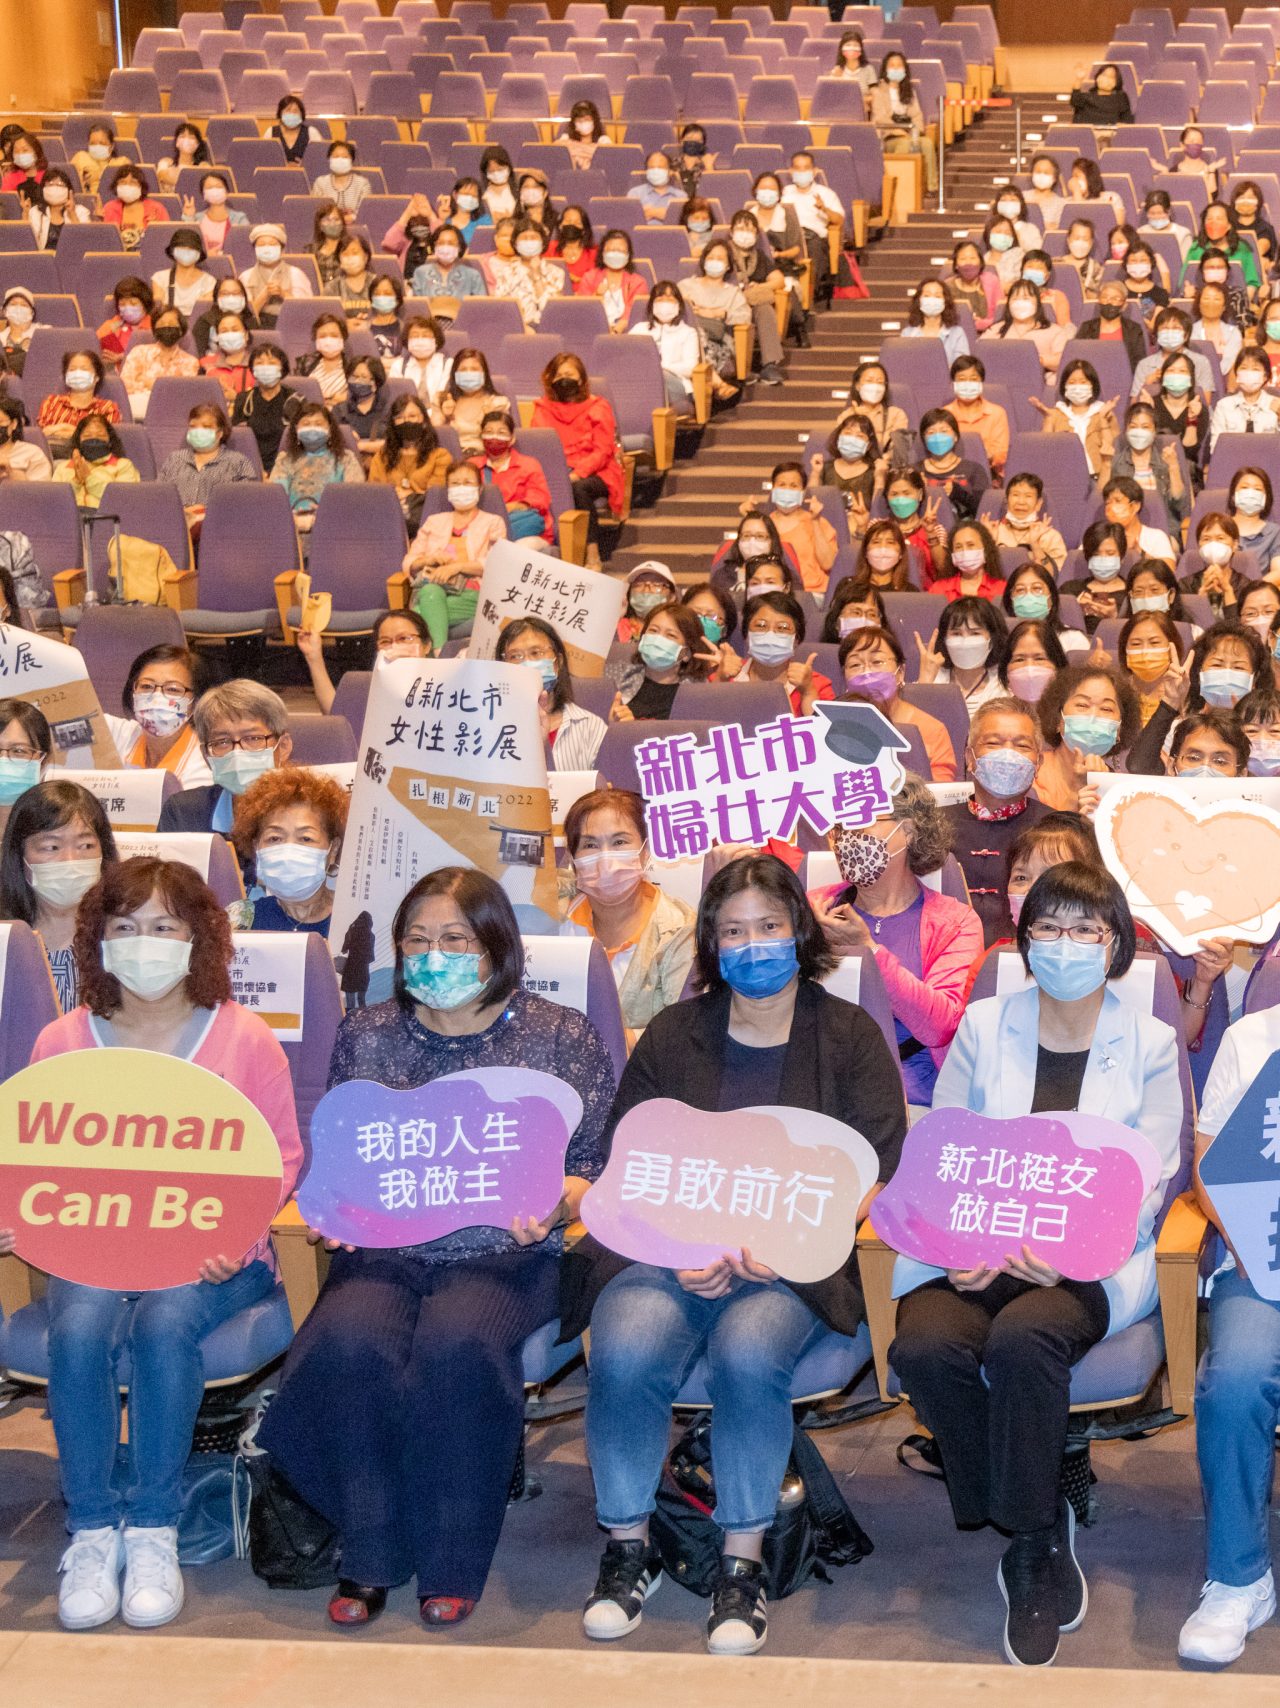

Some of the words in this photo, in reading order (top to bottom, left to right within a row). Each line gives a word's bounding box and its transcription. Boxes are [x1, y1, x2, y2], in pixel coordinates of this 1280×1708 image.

[501, 586, 588, 632] 女性影展
[531, 568, 585, 603] 新北市
[419, 678, 503, 720] 新北市
[386, 716, 522, 760] 女性影展
[638, 717, 817, 796] 新北市
[411, 781, 497, 814] 扎根新北
[496, 794, 533, 806] 2022
[648, 766, 890, 860] 婦女大學
[522, 980, 560, 992] 懷協會
[18, 1101, 245, 1151] Woman
[356, 1112, 521, 1163] 我的人生
[379, 1162, 502, 1210] 我做主
[621, 1149, 835, 1227] 勇敢前行
[936, 1142, 1098, 1199] 新北挺女
[19, 1181, 132, 1228] Can
[149, 1186, 224, 1230] Be
[950, 1192, 1069, 1242] 做自己
